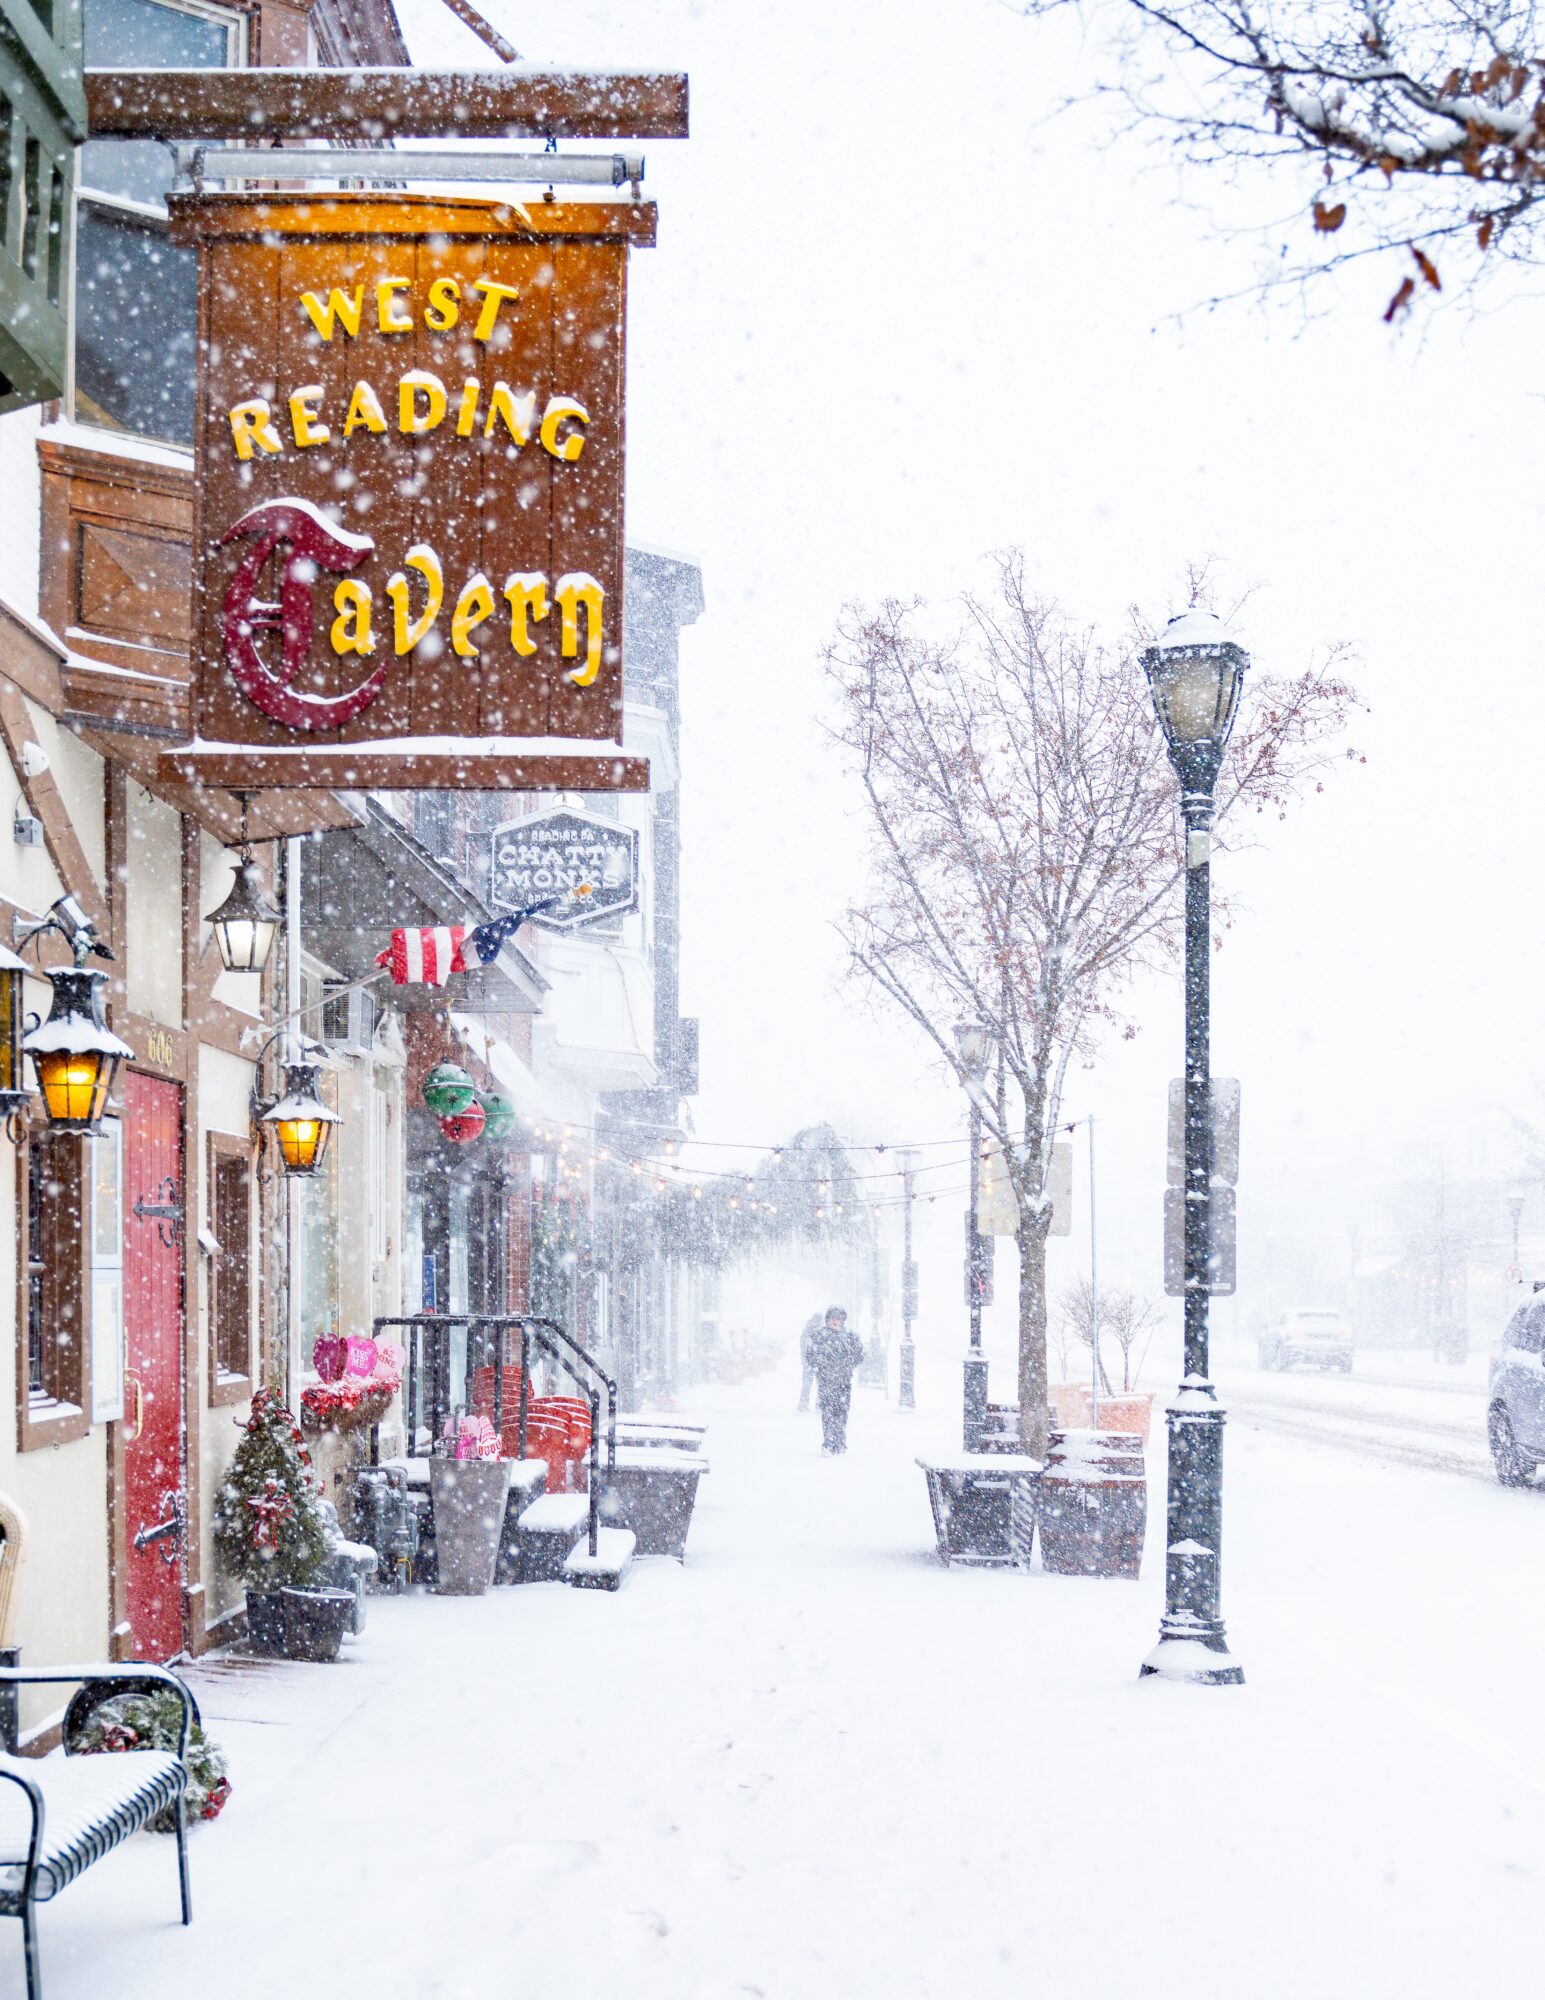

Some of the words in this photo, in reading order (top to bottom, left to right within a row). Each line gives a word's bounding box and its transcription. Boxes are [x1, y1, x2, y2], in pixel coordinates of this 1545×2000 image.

[299, 276, 518, 343] WEST
[229, 369, 591, 462] READING
[216, 496, 605, 731] Tavern
[147, 1028, 172, 1067] 606
[350, 1346, 368, 1360] KISS
